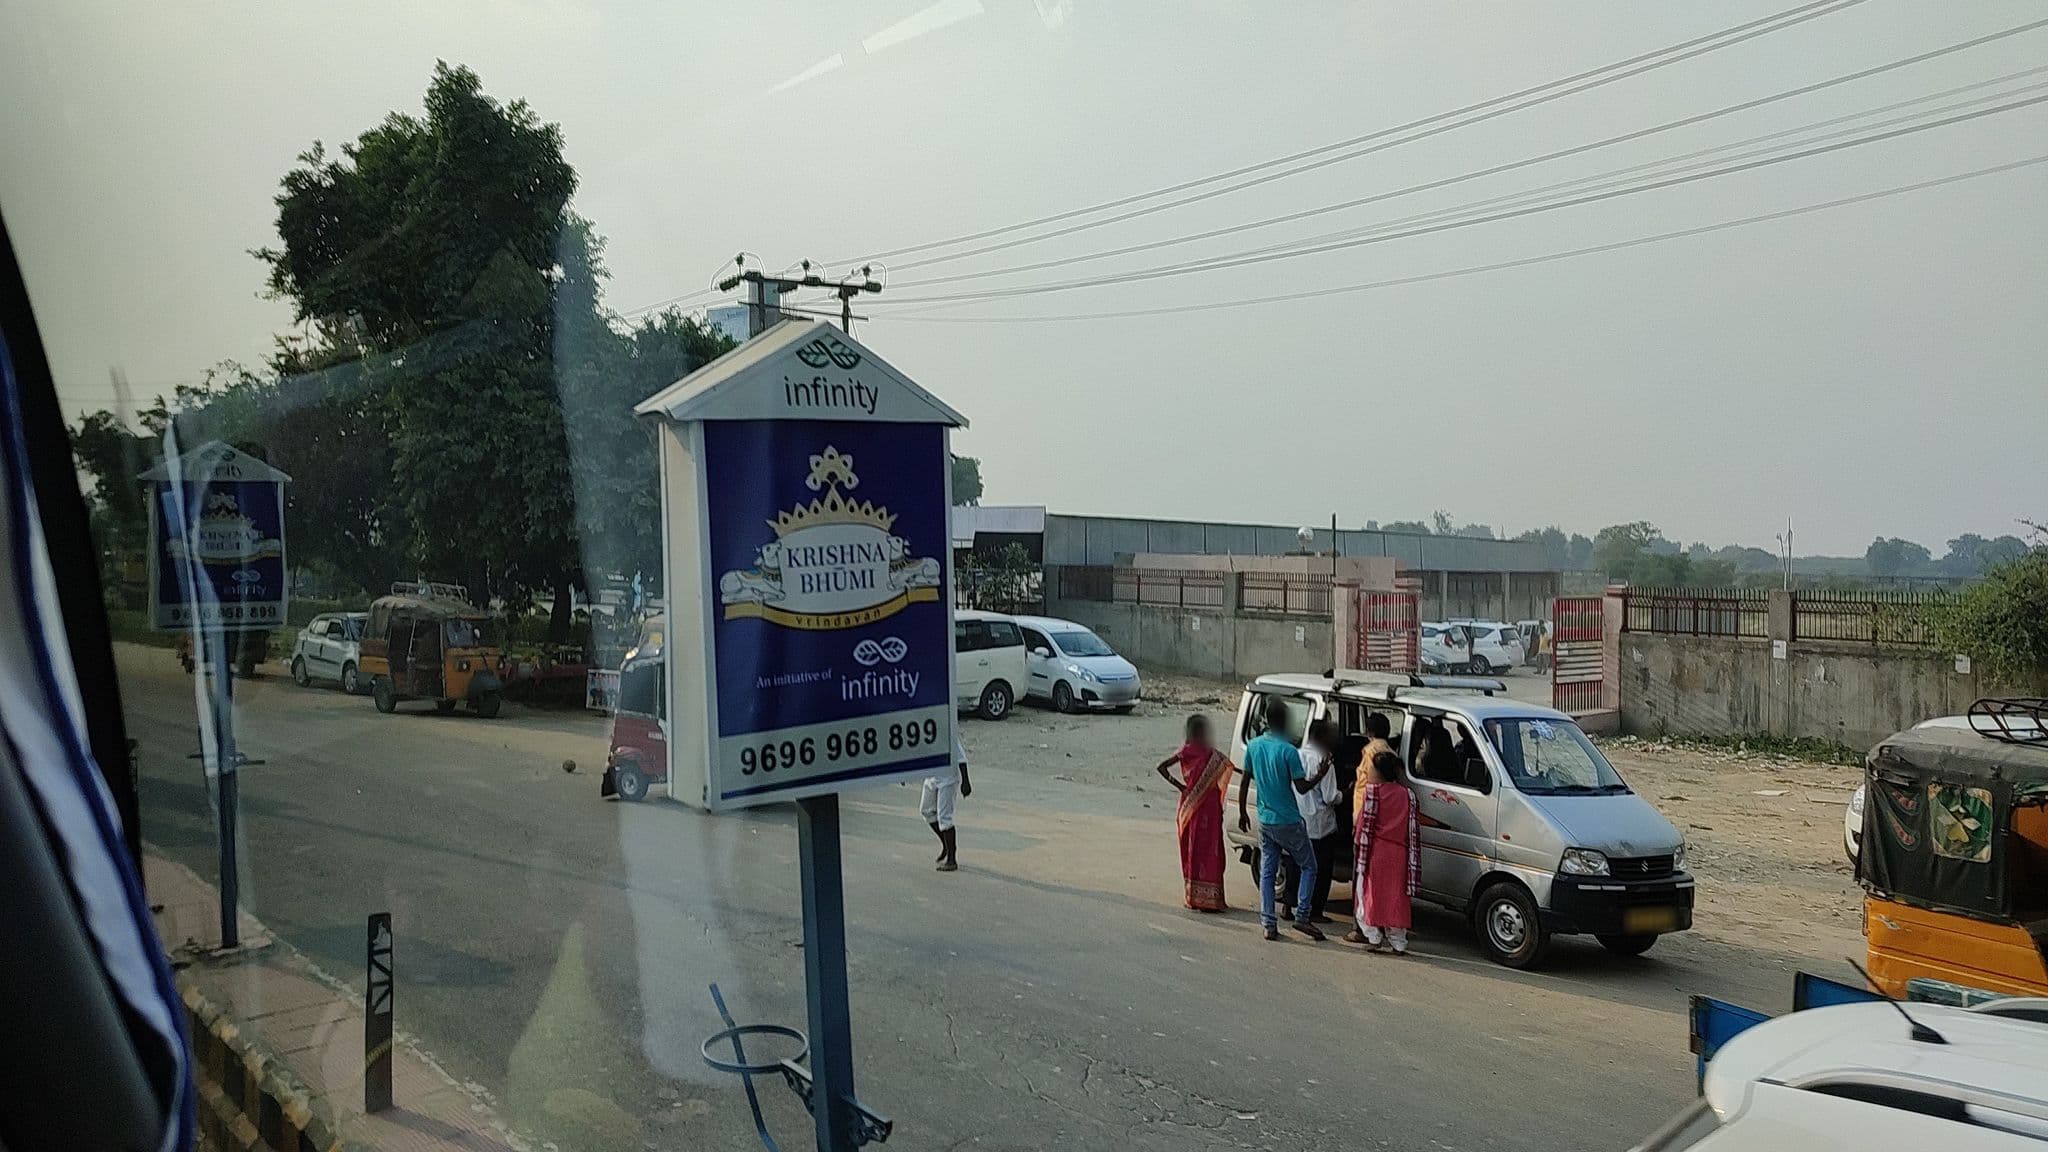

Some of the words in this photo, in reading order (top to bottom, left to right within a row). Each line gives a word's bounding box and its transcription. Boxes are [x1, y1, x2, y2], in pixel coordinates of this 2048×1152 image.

[784, 376, 878, 415] infinity
[786, 542, 886, 569] KRISHNA
[756, 676, 771, 689] An
[774, 671, 820, 686] initiative
[822, 669, 833, 681] of
[841, 668, 919, 701] infinity
[740, 737, 816, 776] 9696
[826, 727, 878, 761] 968
[888, 718, 938, 751] 899
